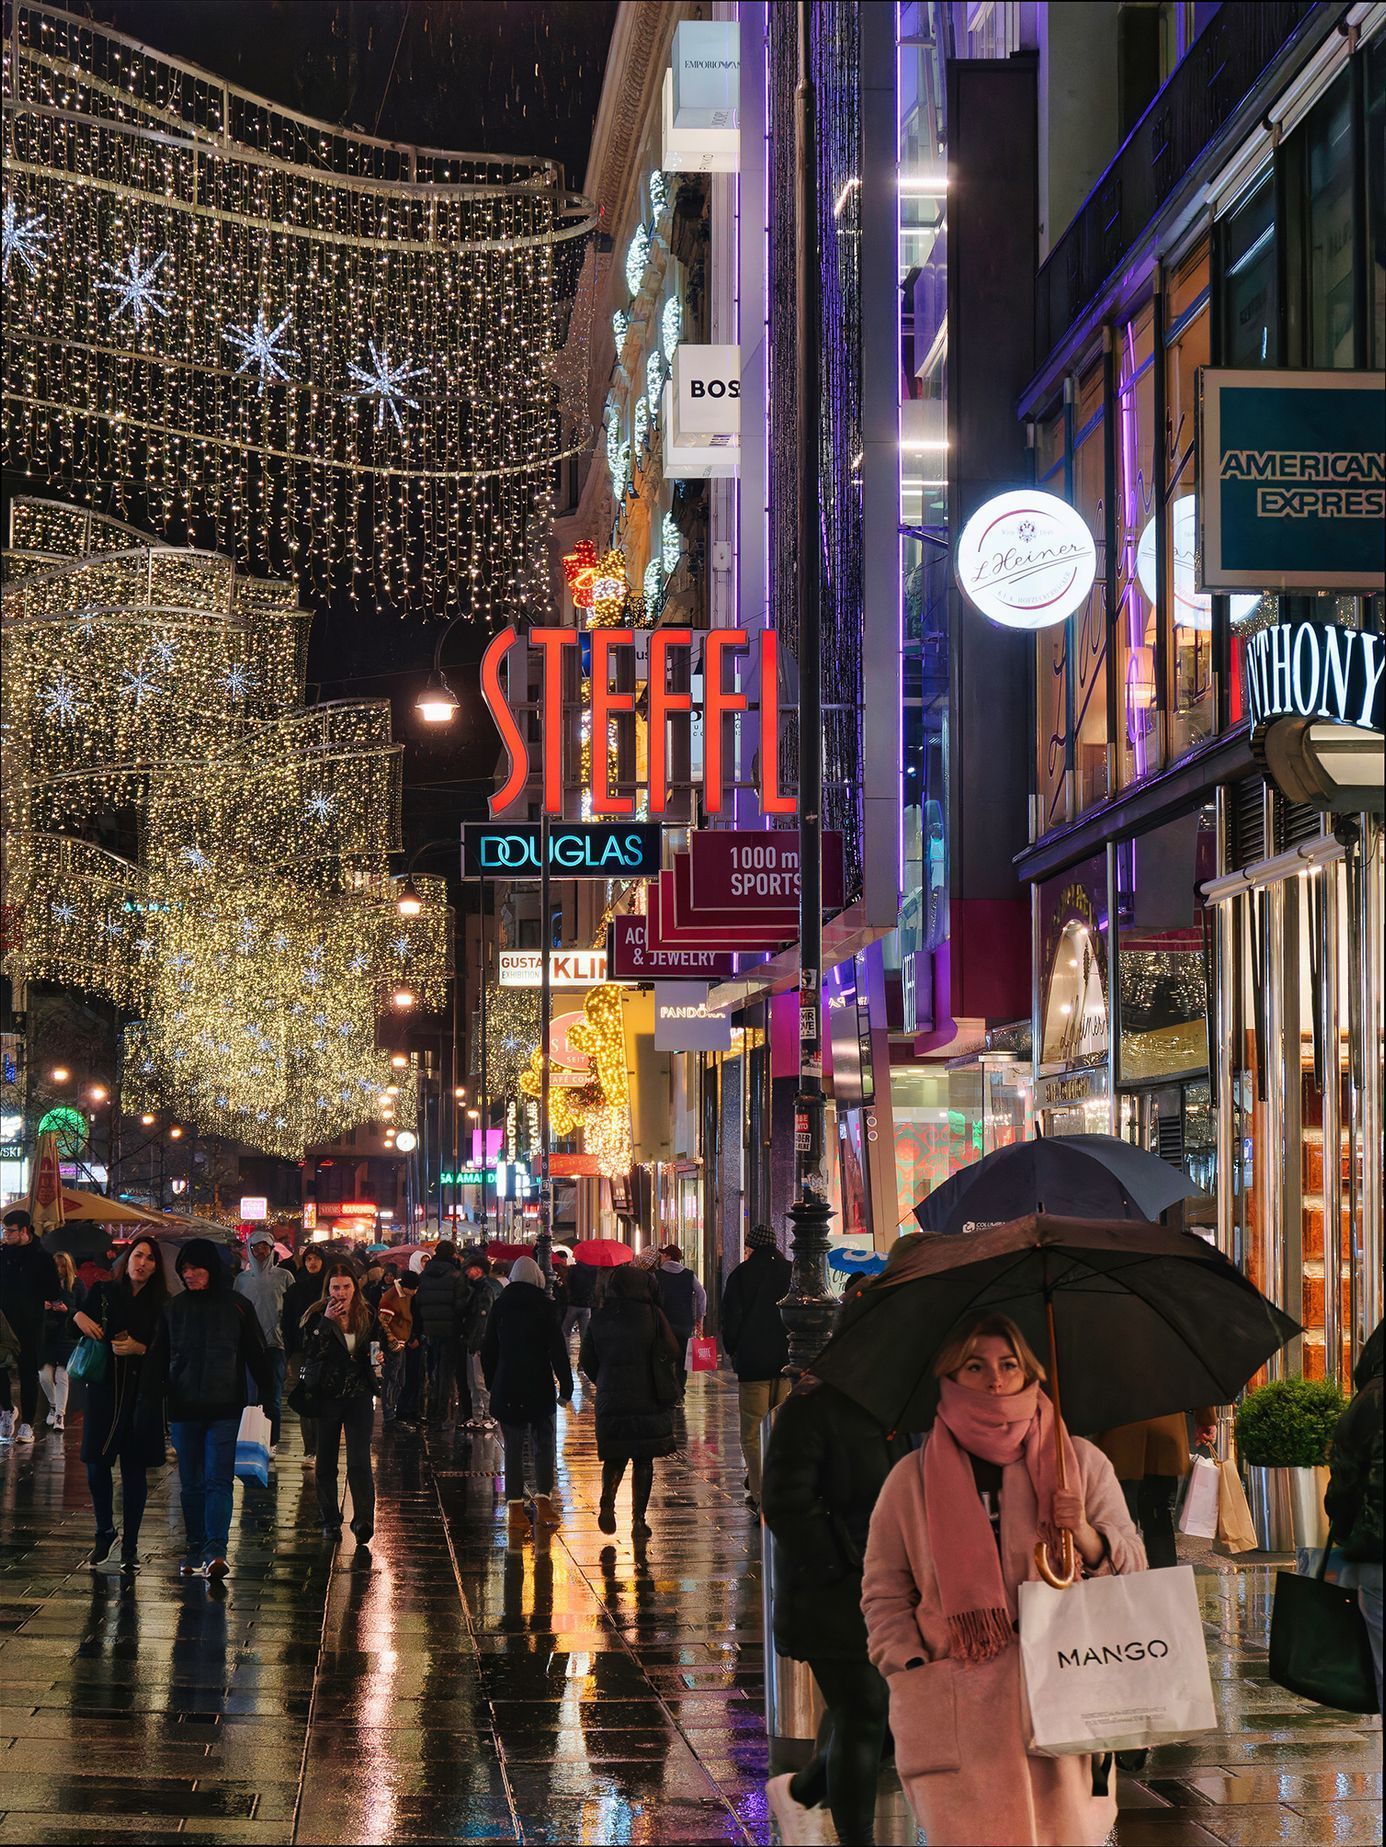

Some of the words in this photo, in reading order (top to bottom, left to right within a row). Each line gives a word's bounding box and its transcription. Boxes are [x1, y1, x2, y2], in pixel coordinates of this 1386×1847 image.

[684, 60, 720, 69] EMPORIO
[691, 379, 740, 398] BOS
[1220, 450, 1385, 480] AMERICAN
[1257, 488, 1385, 518] EXPRES
[481, 626, 799, 820] STEFFL
[480, 834, 644, 868] DOUGLAS
[730, 846, 776, 869] 1000
[730, 873, 801, 896] SPORTS
[501, 957, 552, 968] GUSTA
[633, 948, 644, 966] &
[649, 951, 716, 966] JEWELRY
[1057, 1639, 1168, 1669] MANGO
